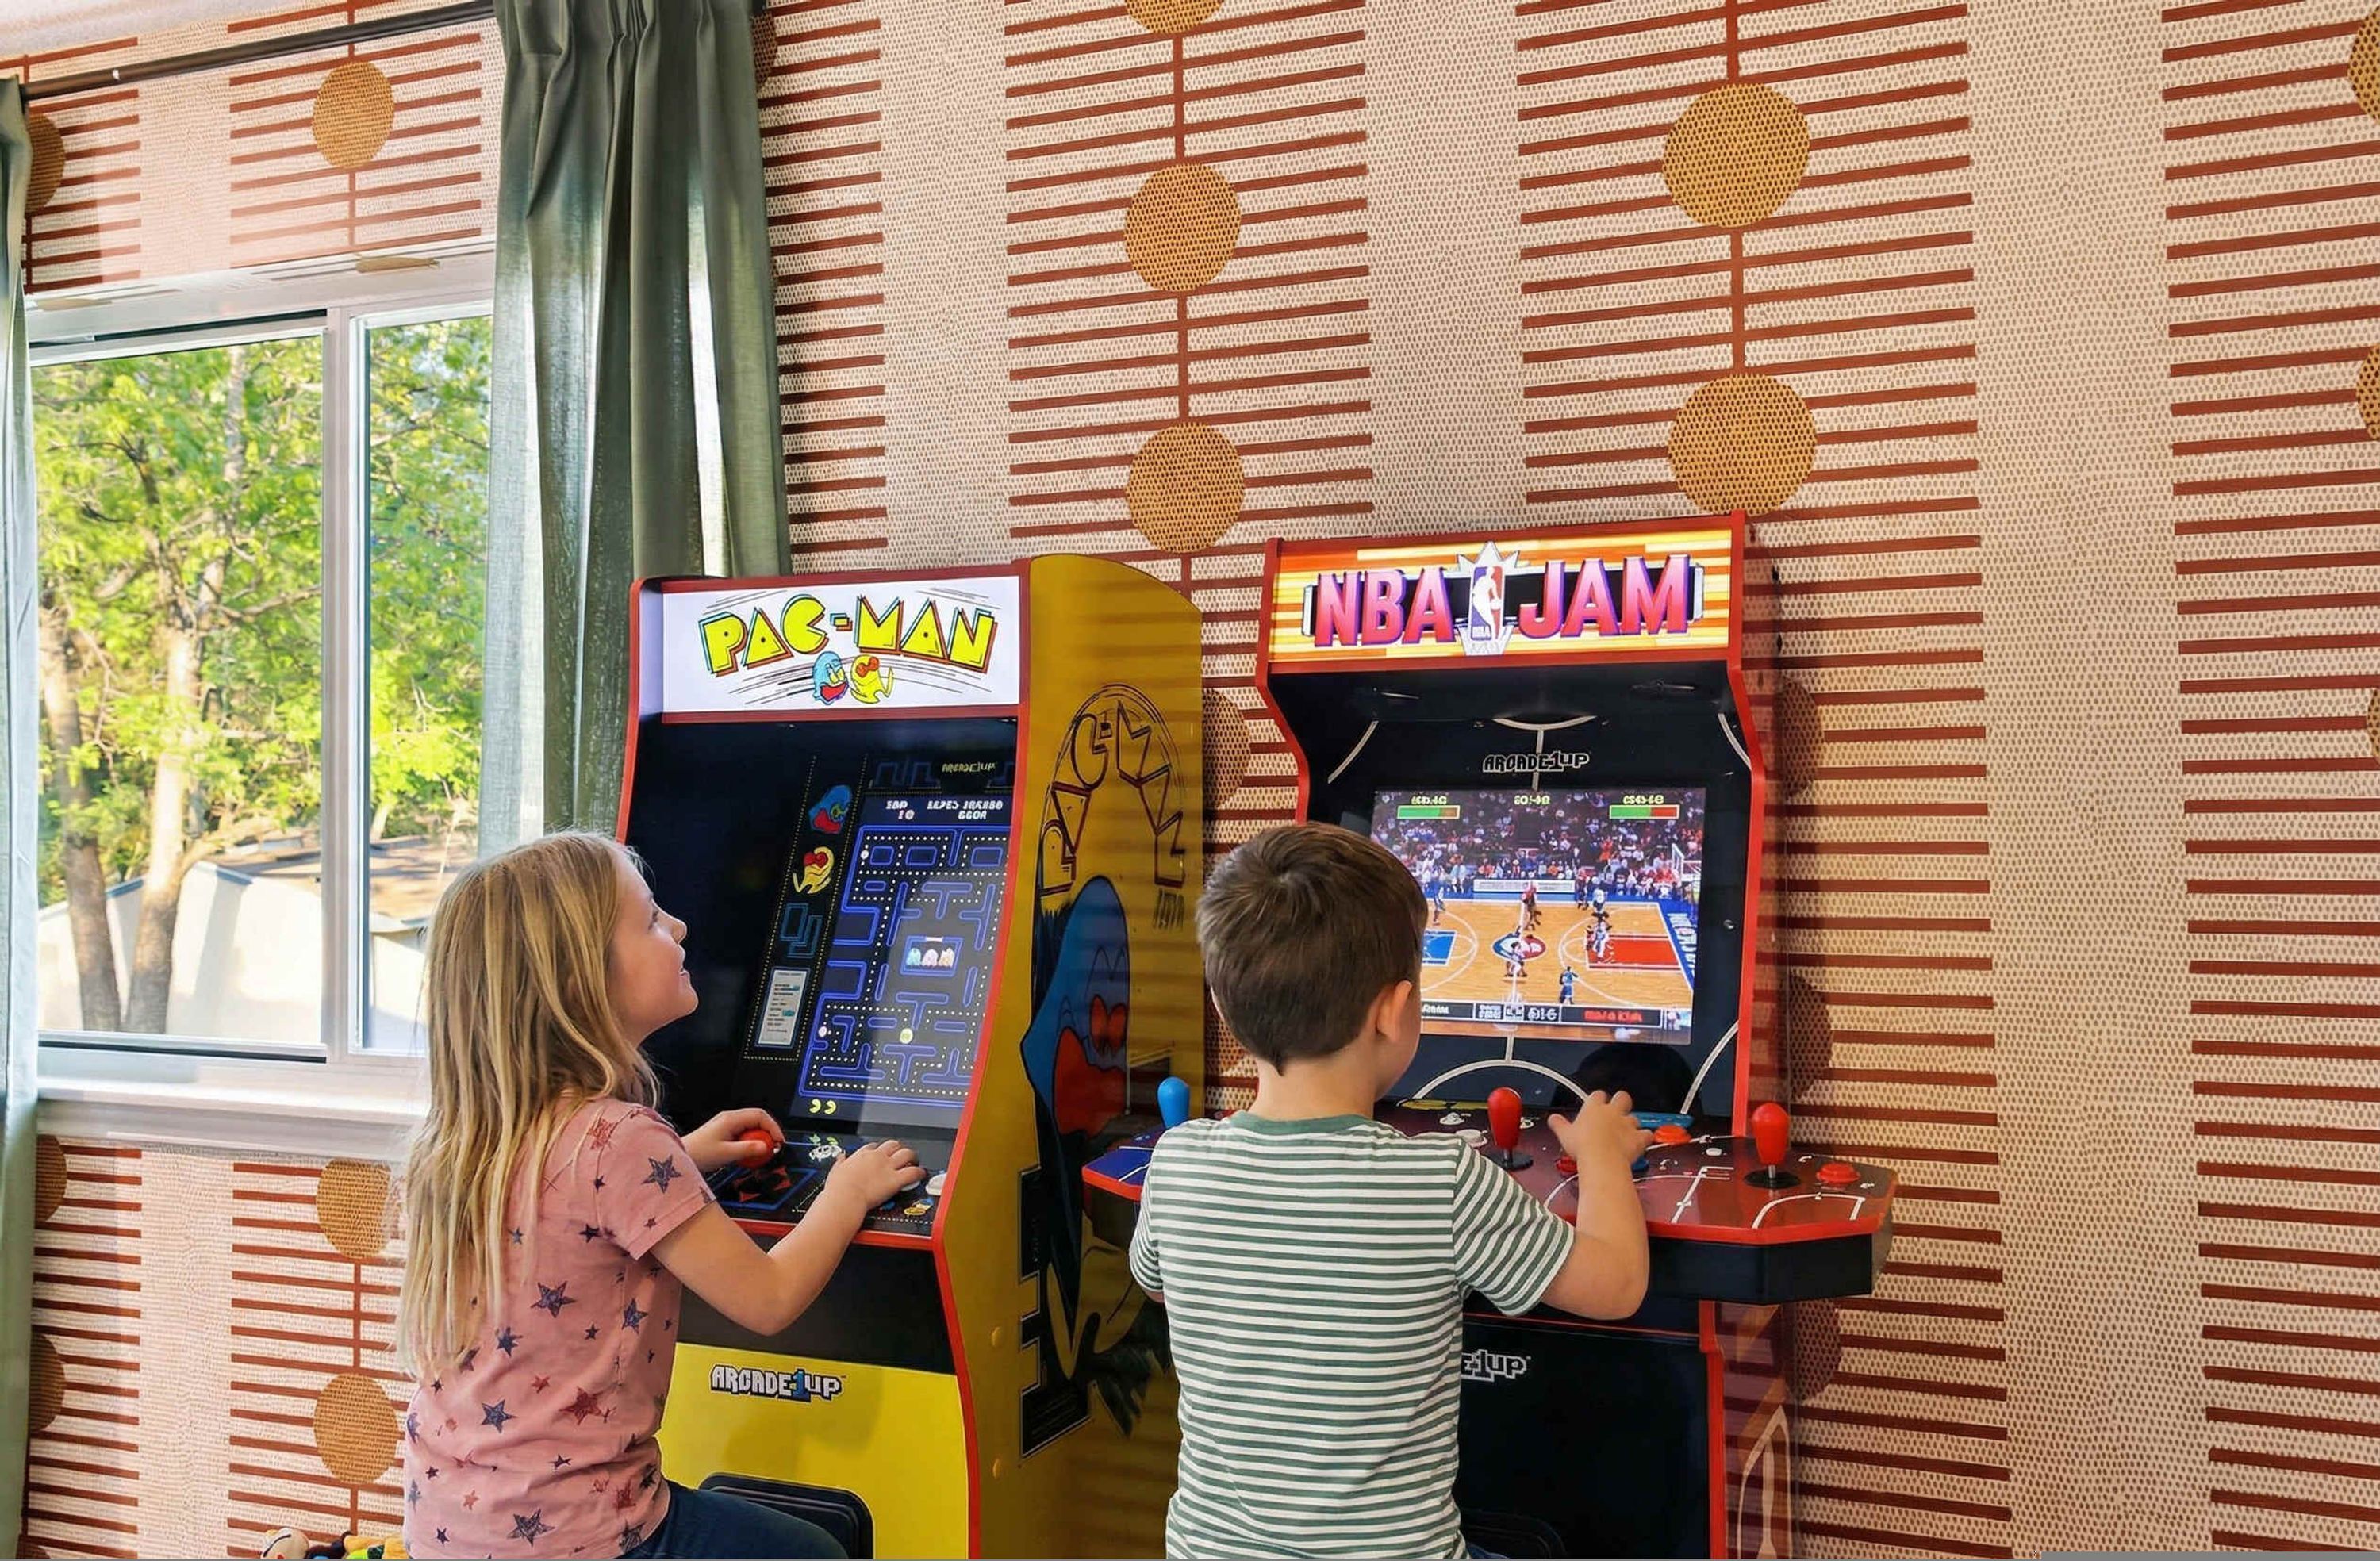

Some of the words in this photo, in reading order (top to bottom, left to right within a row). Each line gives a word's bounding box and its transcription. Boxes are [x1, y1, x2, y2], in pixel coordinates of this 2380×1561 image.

[698, 593, 999, 678] PAC-MAN
[1314, 566, 1457, 647] NBA
[1519, 554, 1691, 638] JAM
